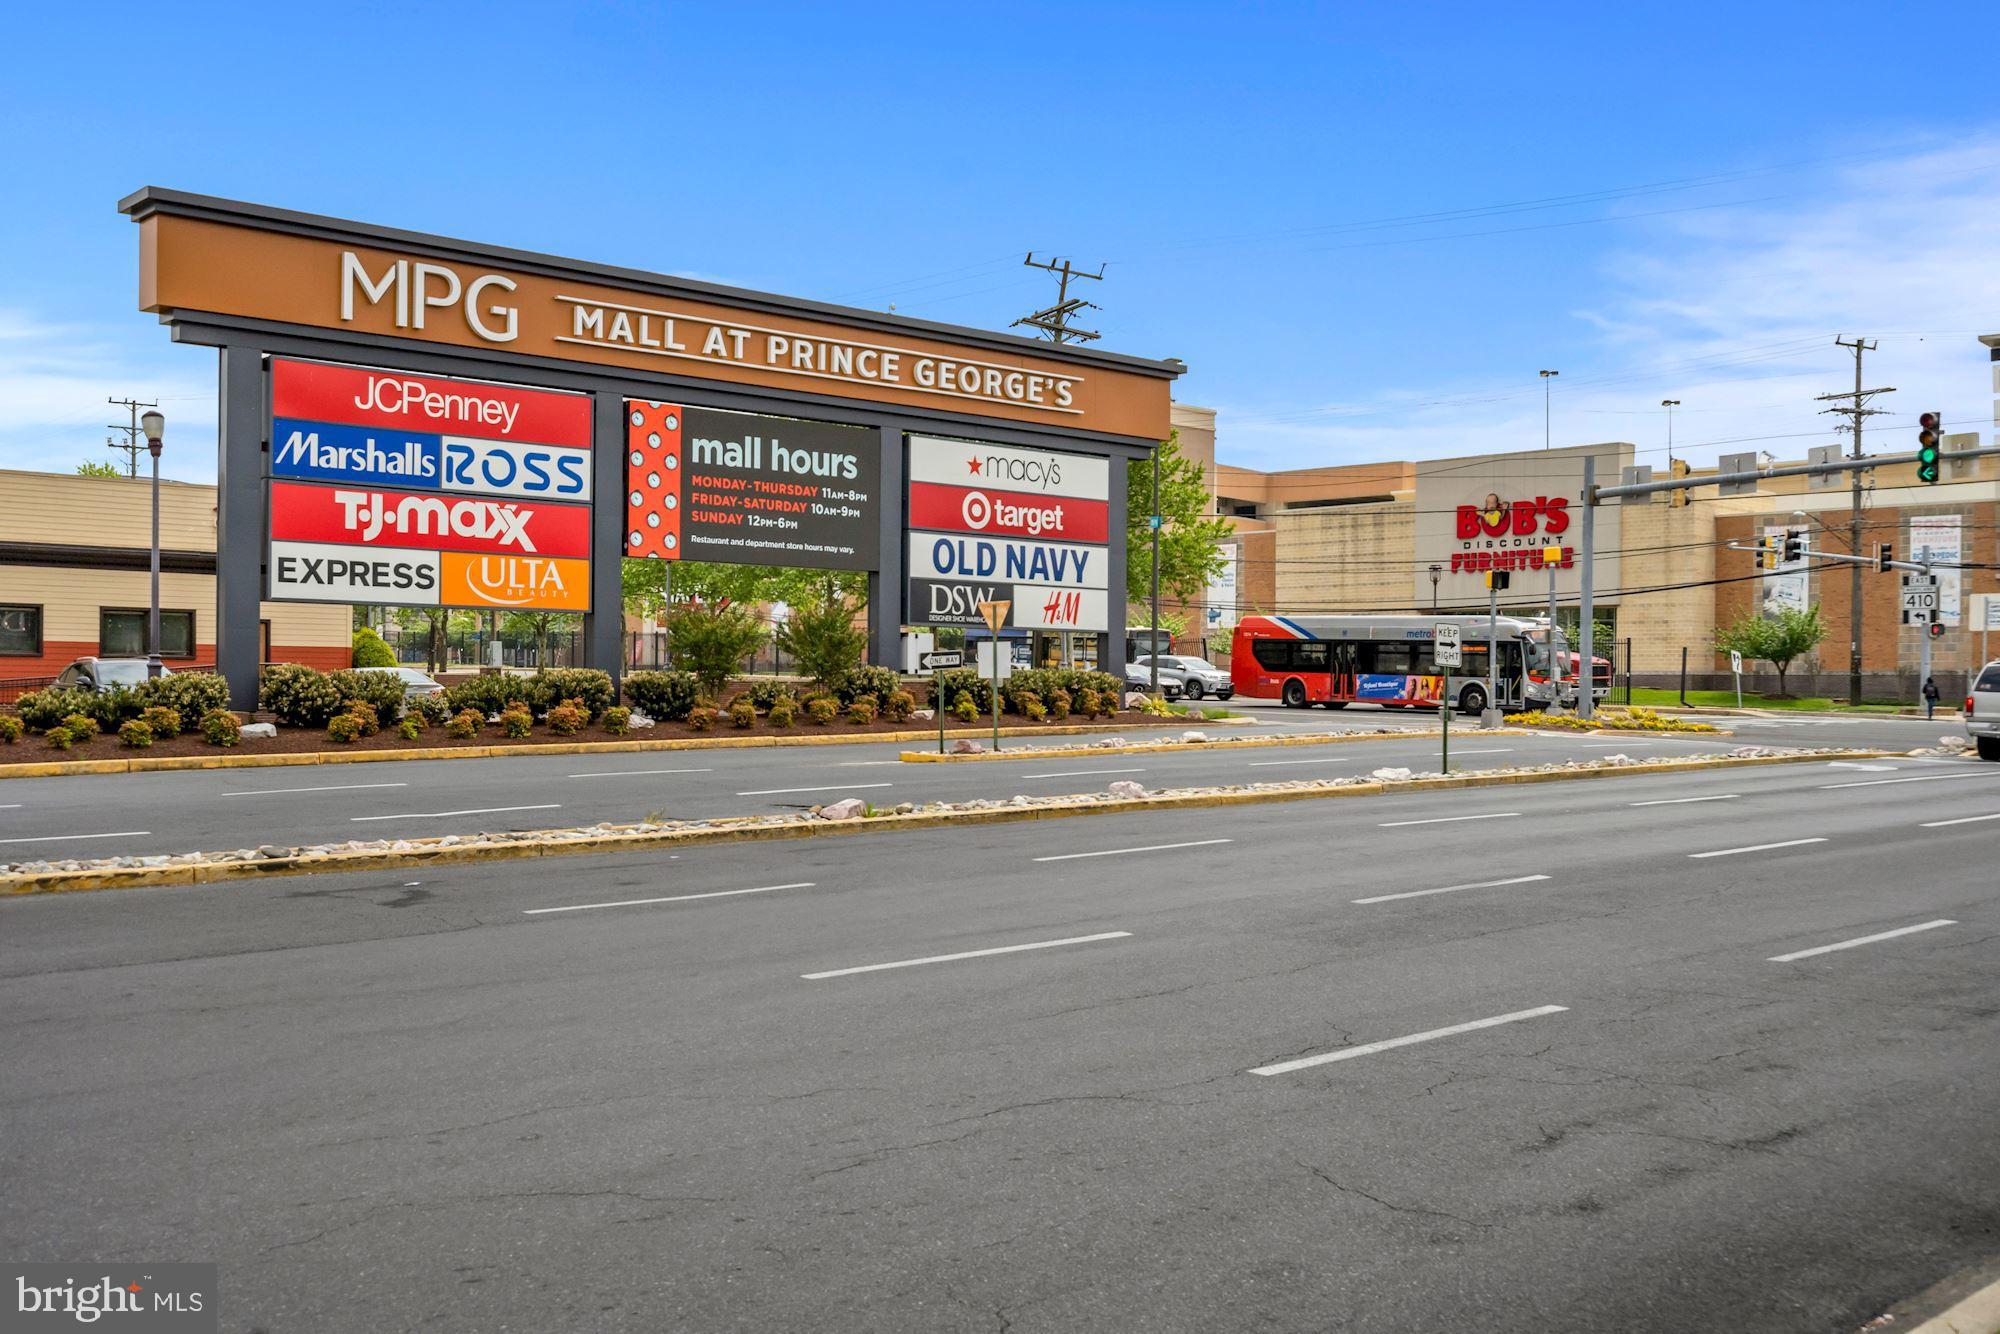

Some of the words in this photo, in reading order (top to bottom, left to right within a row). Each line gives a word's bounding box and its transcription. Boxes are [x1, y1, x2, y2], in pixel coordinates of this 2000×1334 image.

[341, 251, 518, 342] MPG
[573, 305, 687, 350] MALL
[702, 325, 751, 358] AT
[767, 336, 900, 382] PRINCE
[913, 358, 1074, 407] GEORGE'S
[355, 376, 519, 433] JCPenney
[275, 431, 436, 477] Marshalls
[446, 444, 584, 494] ROSS
[692, 436, 761, 469] mall
[772, 439, 858, 479] hours
[692, 475, 819, 497] MONDAY-THURSDAY
[822, 488, 867, 502] 11AM-8PM
[986, 456, 1061, 490] macy's
[692, 493, 807, 513] FRIDAY-SATURDAY
[811, 503, 860, 517] 10AM-9PM
[692, 511, 743, 525] SUNDAY
[748, 515, 798, 529] 12PM-6PM
[994, 499, 1063, 535] target
[1457, 496, 1569, 539] BOB'S
[691, 535, 729, 545] Restaurant
[745, 539, 785, 550] department
[786, 541, 803, 550] store
[804, 543, 823, 552] hours
[824, 545, 838, 554] may
[839, 546, 855, 554] vary.
[1464, 536, 1563, 549] DISCOUNT
[277, 556, 435, 590] EXPRESS
[481, 557, 564, 590] ULTA
[932, 538, 997, 576] OLD
[1006, 544, 1090, 583] NAVY
[1451, 547, 1574, 574] FURNITUE
[507, 589, 569, 599] BEAUTY
[929, 584, 995, 615] DSW
[1043, 591, 1080, 626] H&M
[1906, 594, 1933, 607] 410
[929, 614, 952, 622] DESIGNER
[1438, 628, 1458, 638] KEEP
[930, 656, 943, 665] ONE
[945, 655, 959, 664] WAY
[1436, 651, 1459, 661] RIGHT
